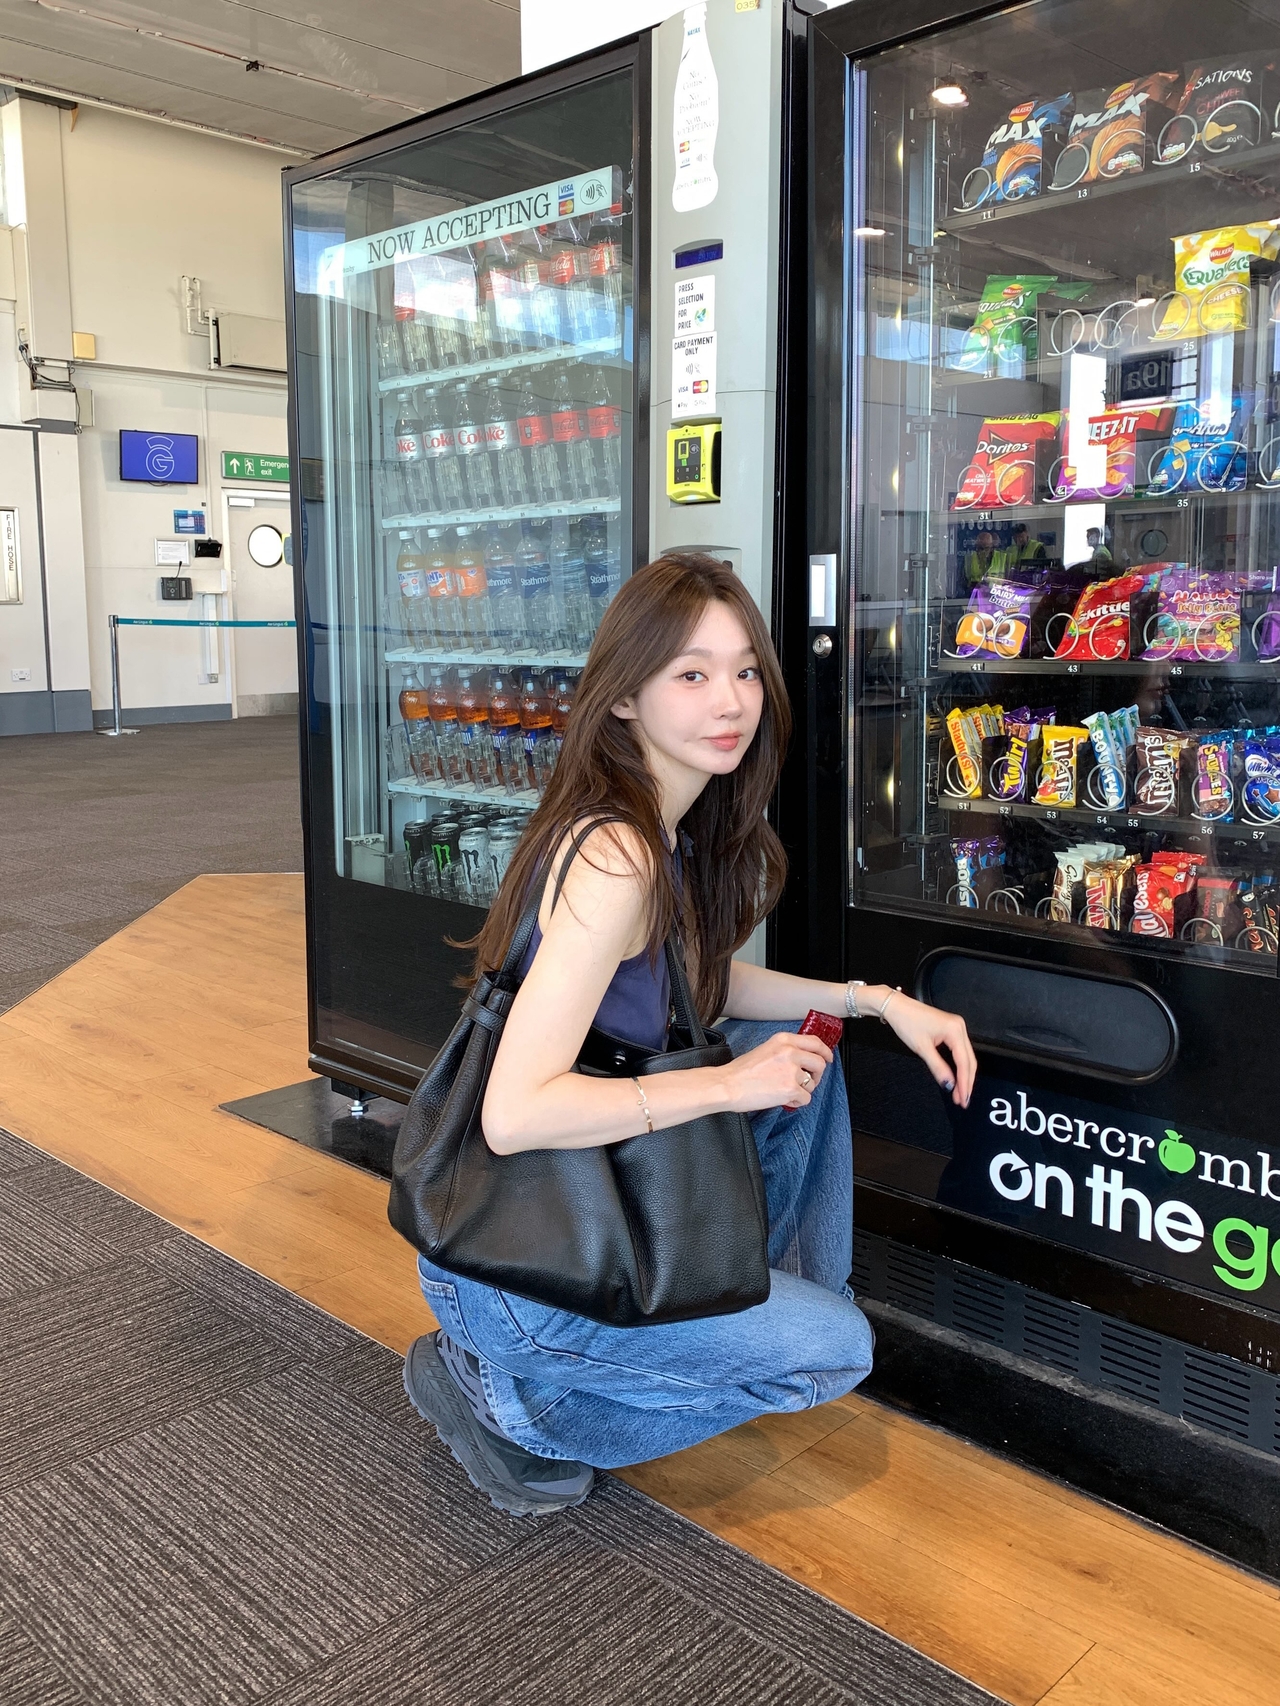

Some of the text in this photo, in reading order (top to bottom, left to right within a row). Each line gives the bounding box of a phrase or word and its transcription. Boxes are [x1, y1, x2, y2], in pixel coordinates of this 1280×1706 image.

[1068, 92, 1150, 137] MAX
[985, 117, 1048, 150] MAX
[1189, 162, 1201, 173] 15
[560, 184, 574, 193] VISA
[1078, 188, 1087, 198] 13
[982, 211, 992, 220] 11
[368, 192, 552, 264] NOW ACCEPTING
[1210, 246, 1234, 258] WALKERS
[679, 282, 694, 293] PRESS
[678, 293, 704, 306] SELECTION
[1207, 287, 1243, 304] CHEESE
[678, 309, 687, 318] FOR
[678, 320, 691, 330] PRICE
[674, 336, 714, 350] CARD PAYMENT
[1183, 341, 1195, 351] 25
[685, 347, 699, 356] ONLY
[975, 441, 1030, 454] Doritos
[261, 468, 273, 476] exit
[1177, 498, 1189, 507] 35
[979, 512, 989, 520] 31
[990, 588, 1014, 600] DAIRY
[1176, 601, 1237, 614] Jelly Beans
[972, 663, 982, 671] 41
[1067, 665, 1078, 673] 43
[1170, 666, 1183, 675] 45
[1003, 736, 1027, 794] Twirl
[1091, 729, 1119, 793] BOUNTY
[1046, 811, 1057, 819] 53
[1096, 816, 1107, 824] 54
[1128, 819, 1139, 828] 55
[1201, 827, 1213, 835] 56
[1252, 831, 1265, 840] 57
[957, 858, 971, 908] BOOST
[1061, 865, 1077, 901] Galaxy
[988, 1149, 1280, 1291] on the g
